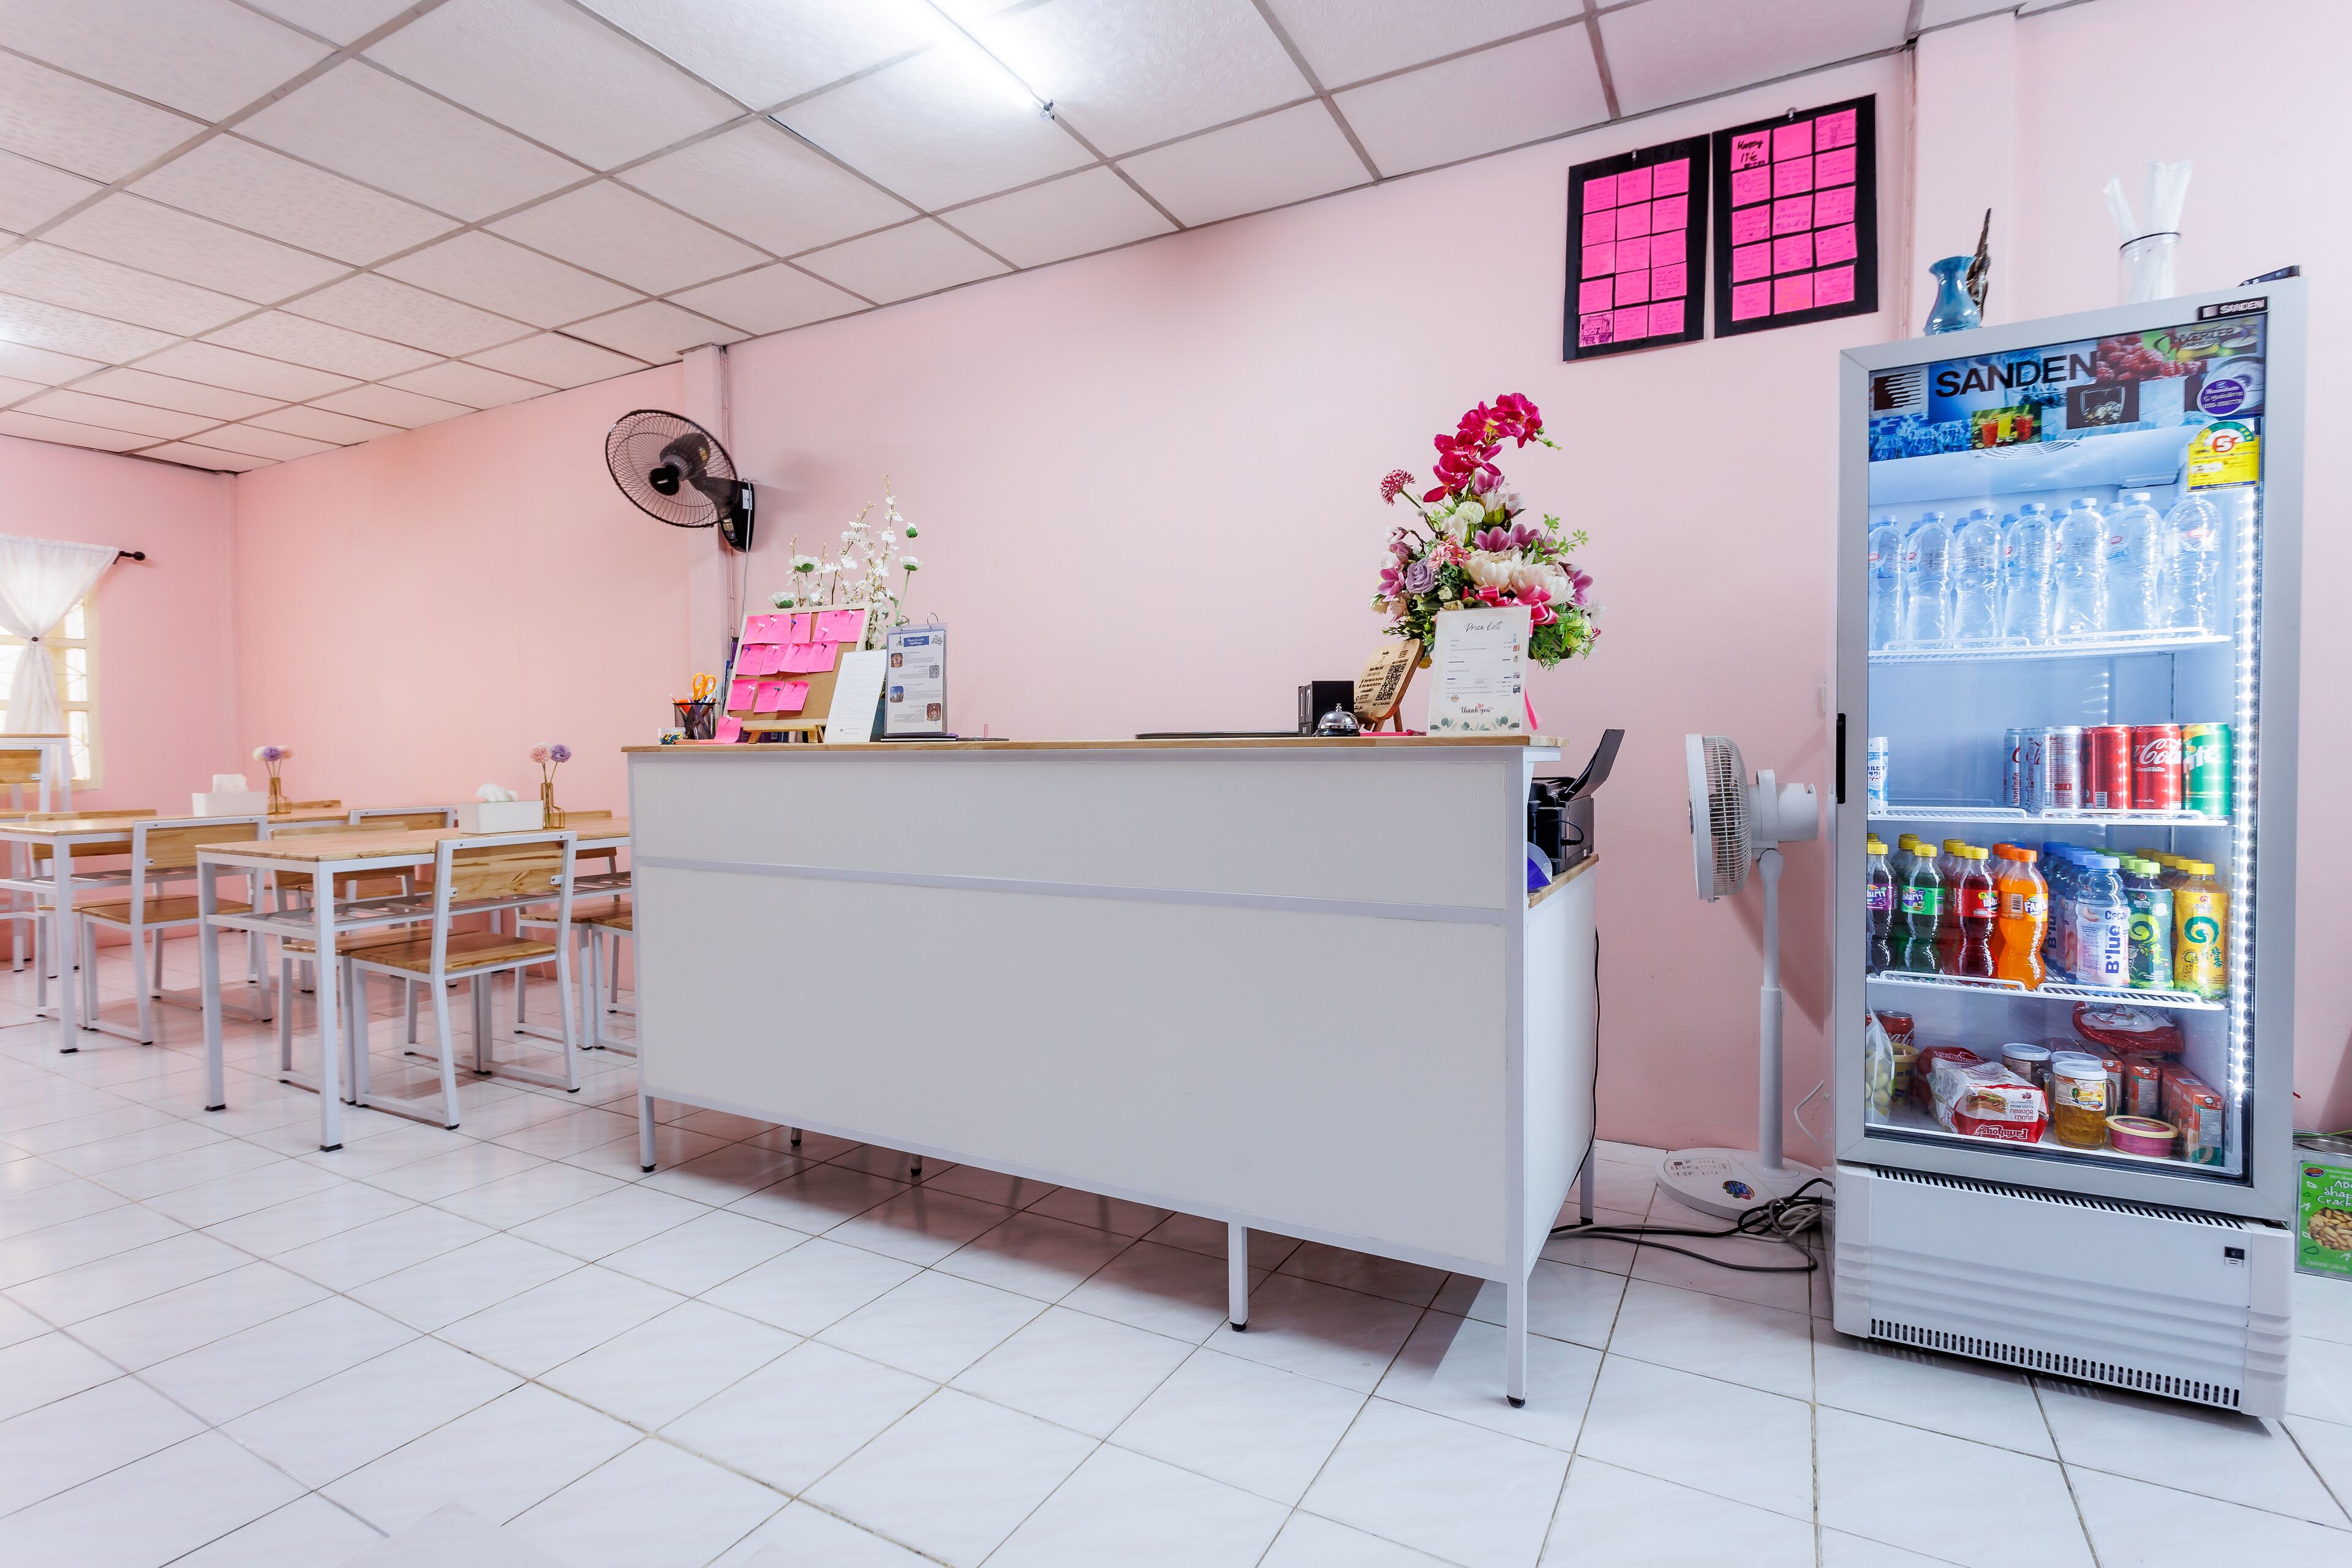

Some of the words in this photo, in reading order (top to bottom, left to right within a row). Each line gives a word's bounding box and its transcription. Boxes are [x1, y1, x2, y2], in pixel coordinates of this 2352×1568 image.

[2219, 299, 2265, 314] SANDEN
[1935, 350, 2098, 398] SANDEN
[1464, 622, 1485, 633] Price
[1487, 620, 1504, 631] List
[1974, 1125, 2029, 1140] Farmhouse
